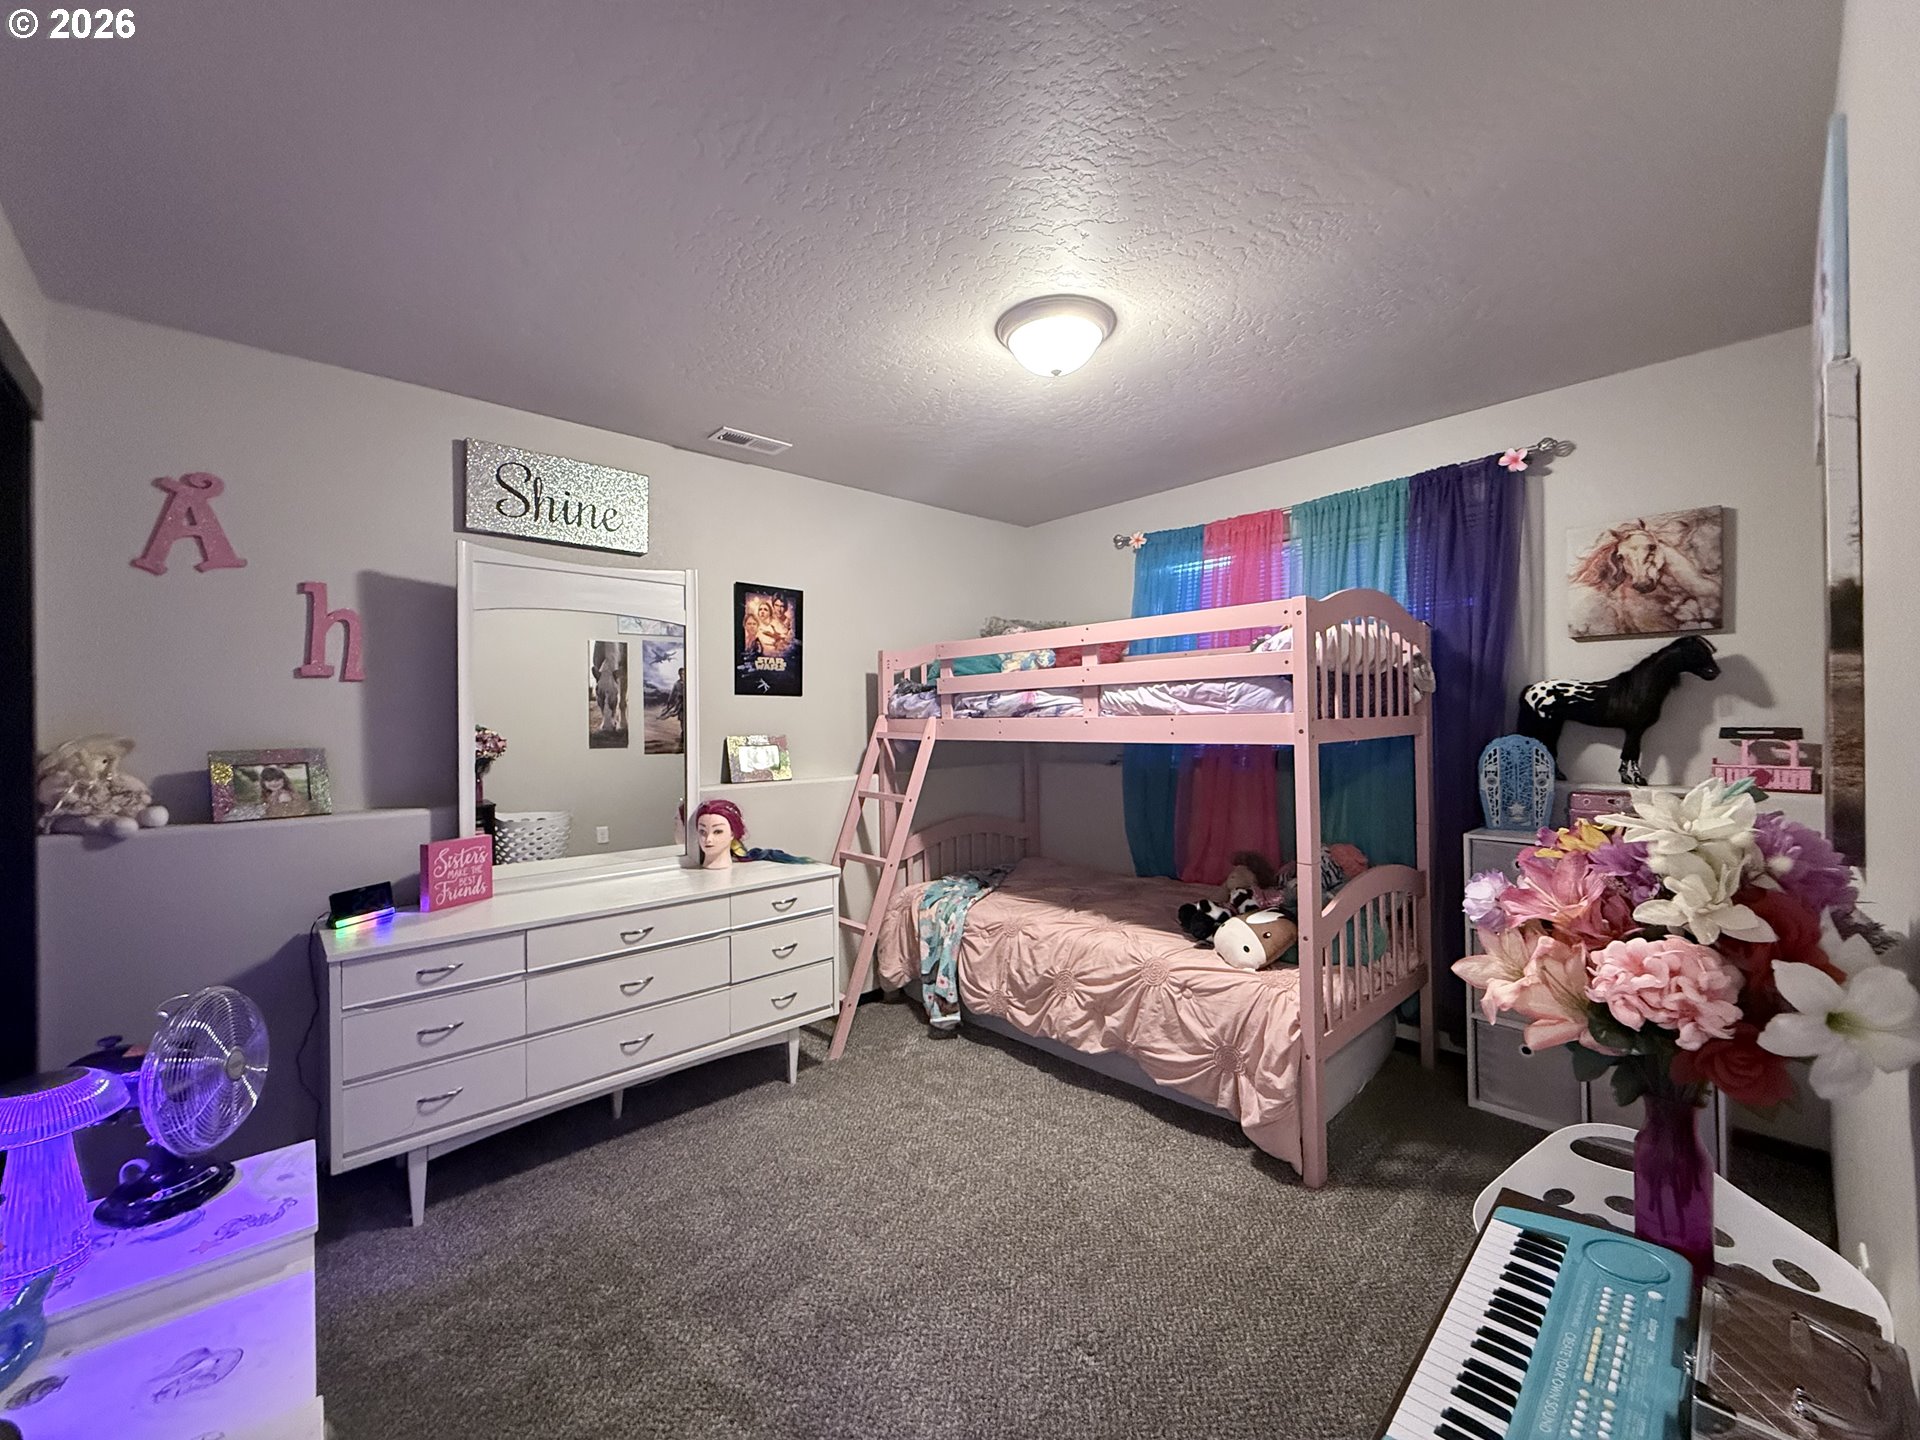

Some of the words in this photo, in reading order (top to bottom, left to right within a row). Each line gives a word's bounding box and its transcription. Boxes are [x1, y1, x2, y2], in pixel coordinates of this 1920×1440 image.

[496, 462, 624, 532] Shine
[129, 472, 248, 576] A
[293, 581, 366, 682] h
[755, 661, 787, 671] WARS
[757, 656, 785, 664] STAR
[447, 869, 468, 879] MAKE
[471, 865, 483, 874] THE
[458, 875, 477, 887] BEST
[434, 875, 488, 905] Friends
[1560, 1331, 1578, 1357] CREATE
[1554, 1356, 1569, 1379] YOUR
[1548, 1378, 1564, 1401] OWN
[1539, 1400, 1558, 1433] SOUND
